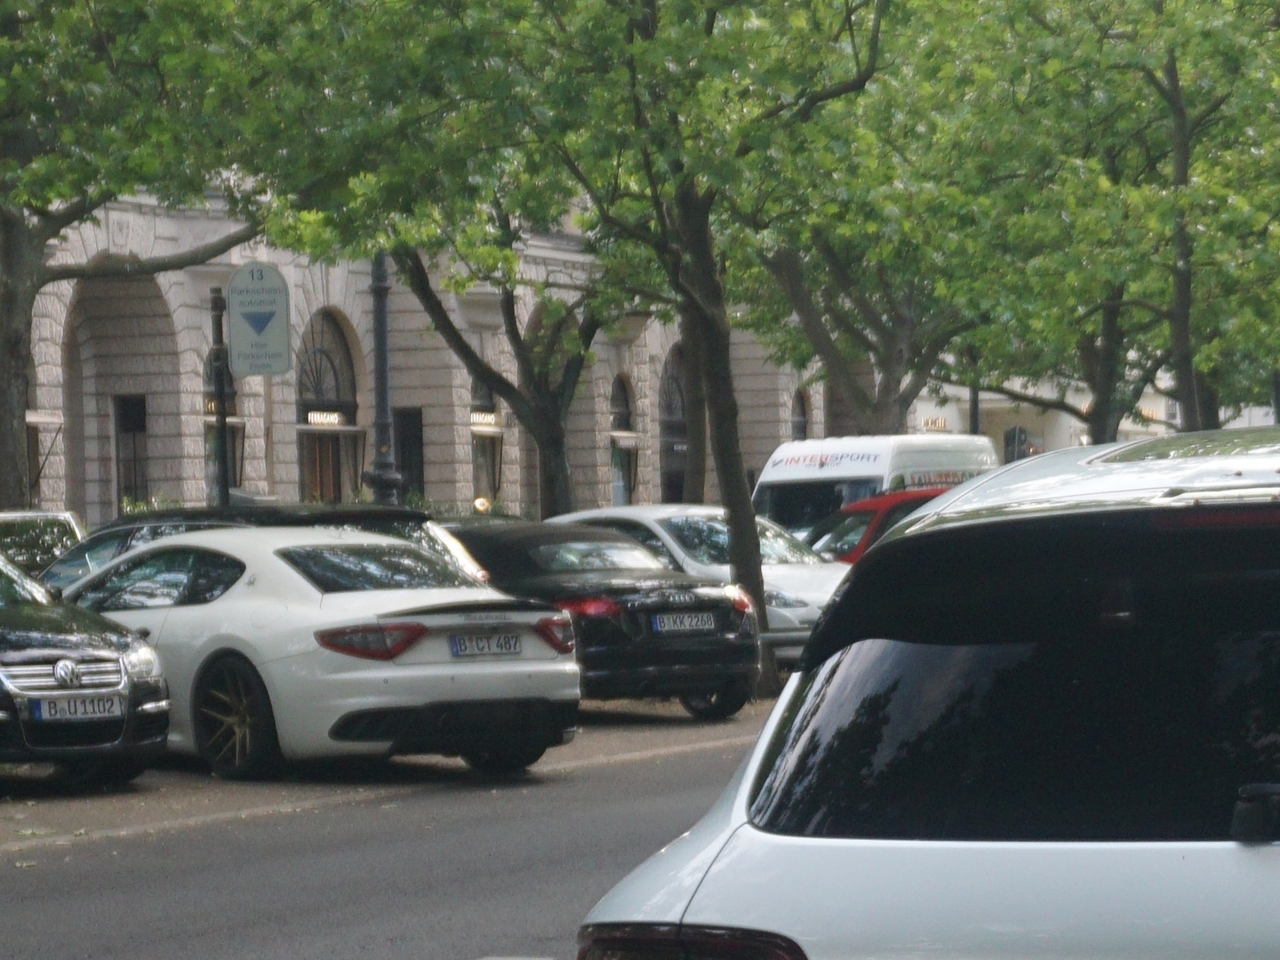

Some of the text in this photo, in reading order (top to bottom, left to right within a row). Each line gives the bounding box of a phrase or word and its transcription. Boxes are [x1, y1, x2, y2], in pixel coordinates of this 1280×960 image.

[248, 268, 264, 282] 13
[784, 452, 880, 466] INTERSPORT
[457, 633, 519, 653] B CT 487
[47, 700, 59, 718] B
[81, 698, 116, 716] 1102
